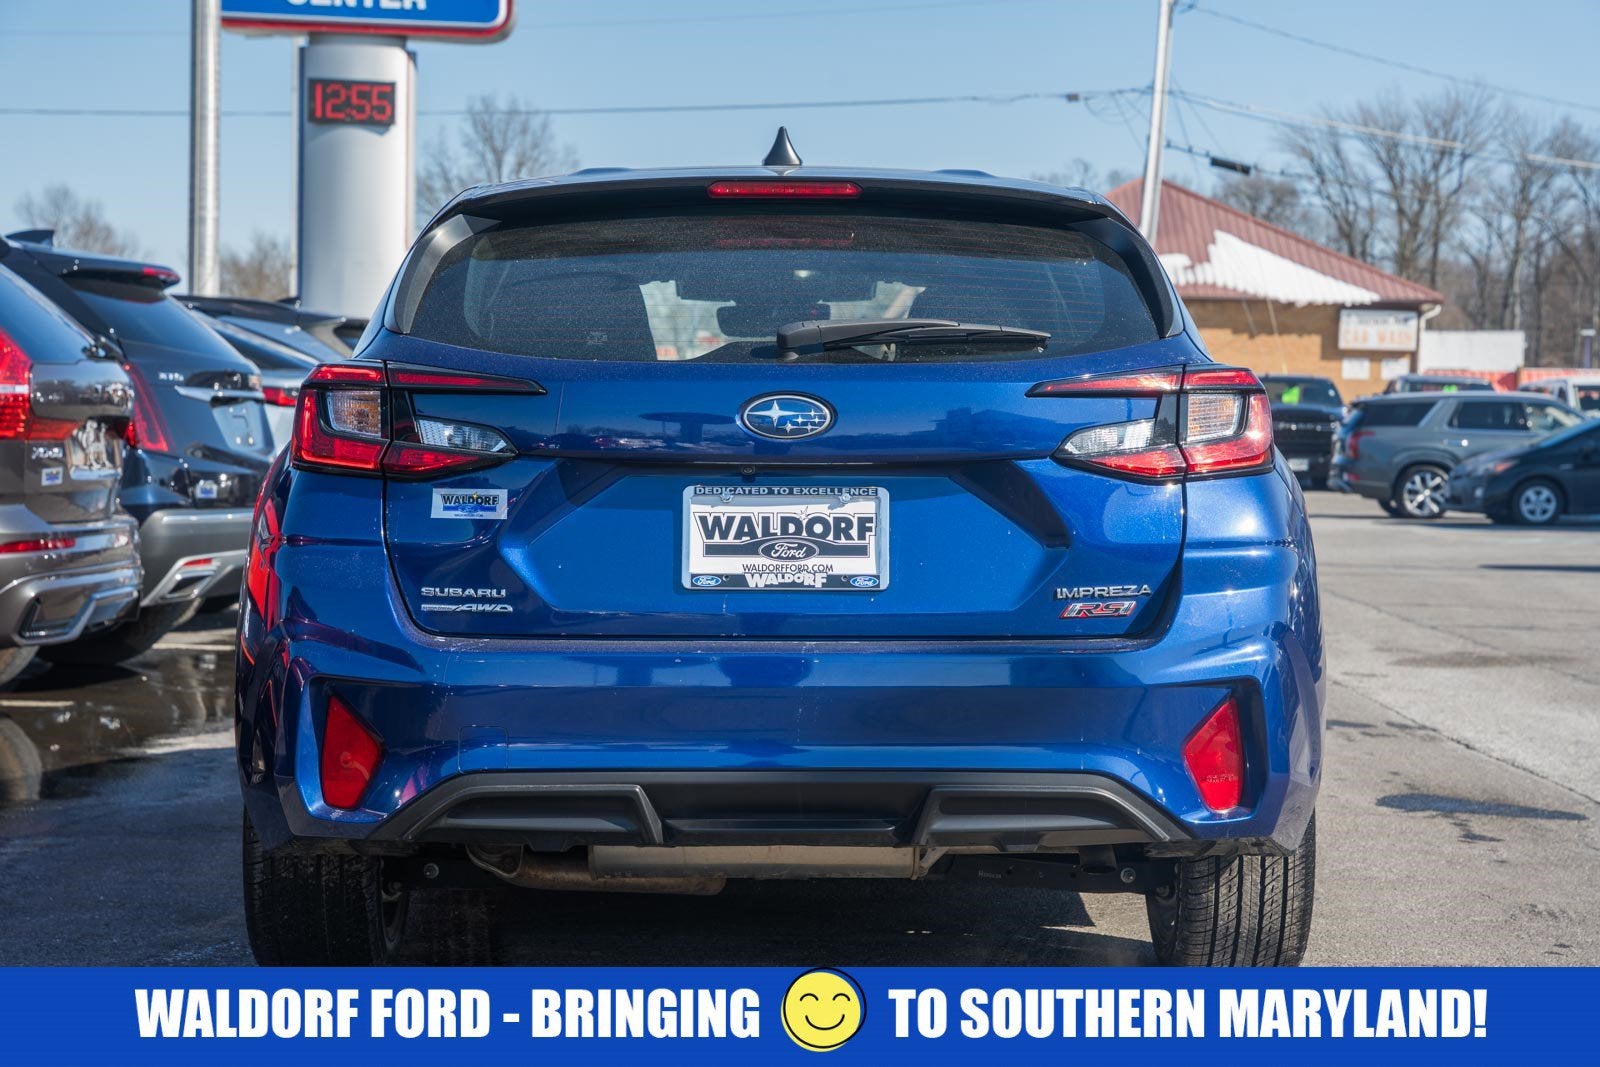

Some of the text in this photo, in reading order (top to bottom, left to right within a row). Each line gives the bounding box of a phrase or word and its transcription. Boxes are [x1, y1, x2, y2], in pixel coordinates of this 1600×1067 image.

[314, 82, 393, 121] 12:55
[695, 487, 877, 496] DEDICATED TO EXCELLENCE
[441, 494, 499, 505] WALDORF
[698, 514, 875, 541] WALDORF
[771, 542, 807, 559] Ford
[742, 563, 834, 573] WALDORFFORD.COM
[744, 572, 828, 588] WALDORF
[421, 587, 506, 598] SUBARU
[1056, 584, 1151, 599] IMPREZA
[458, 603, 513, 612] AWD
